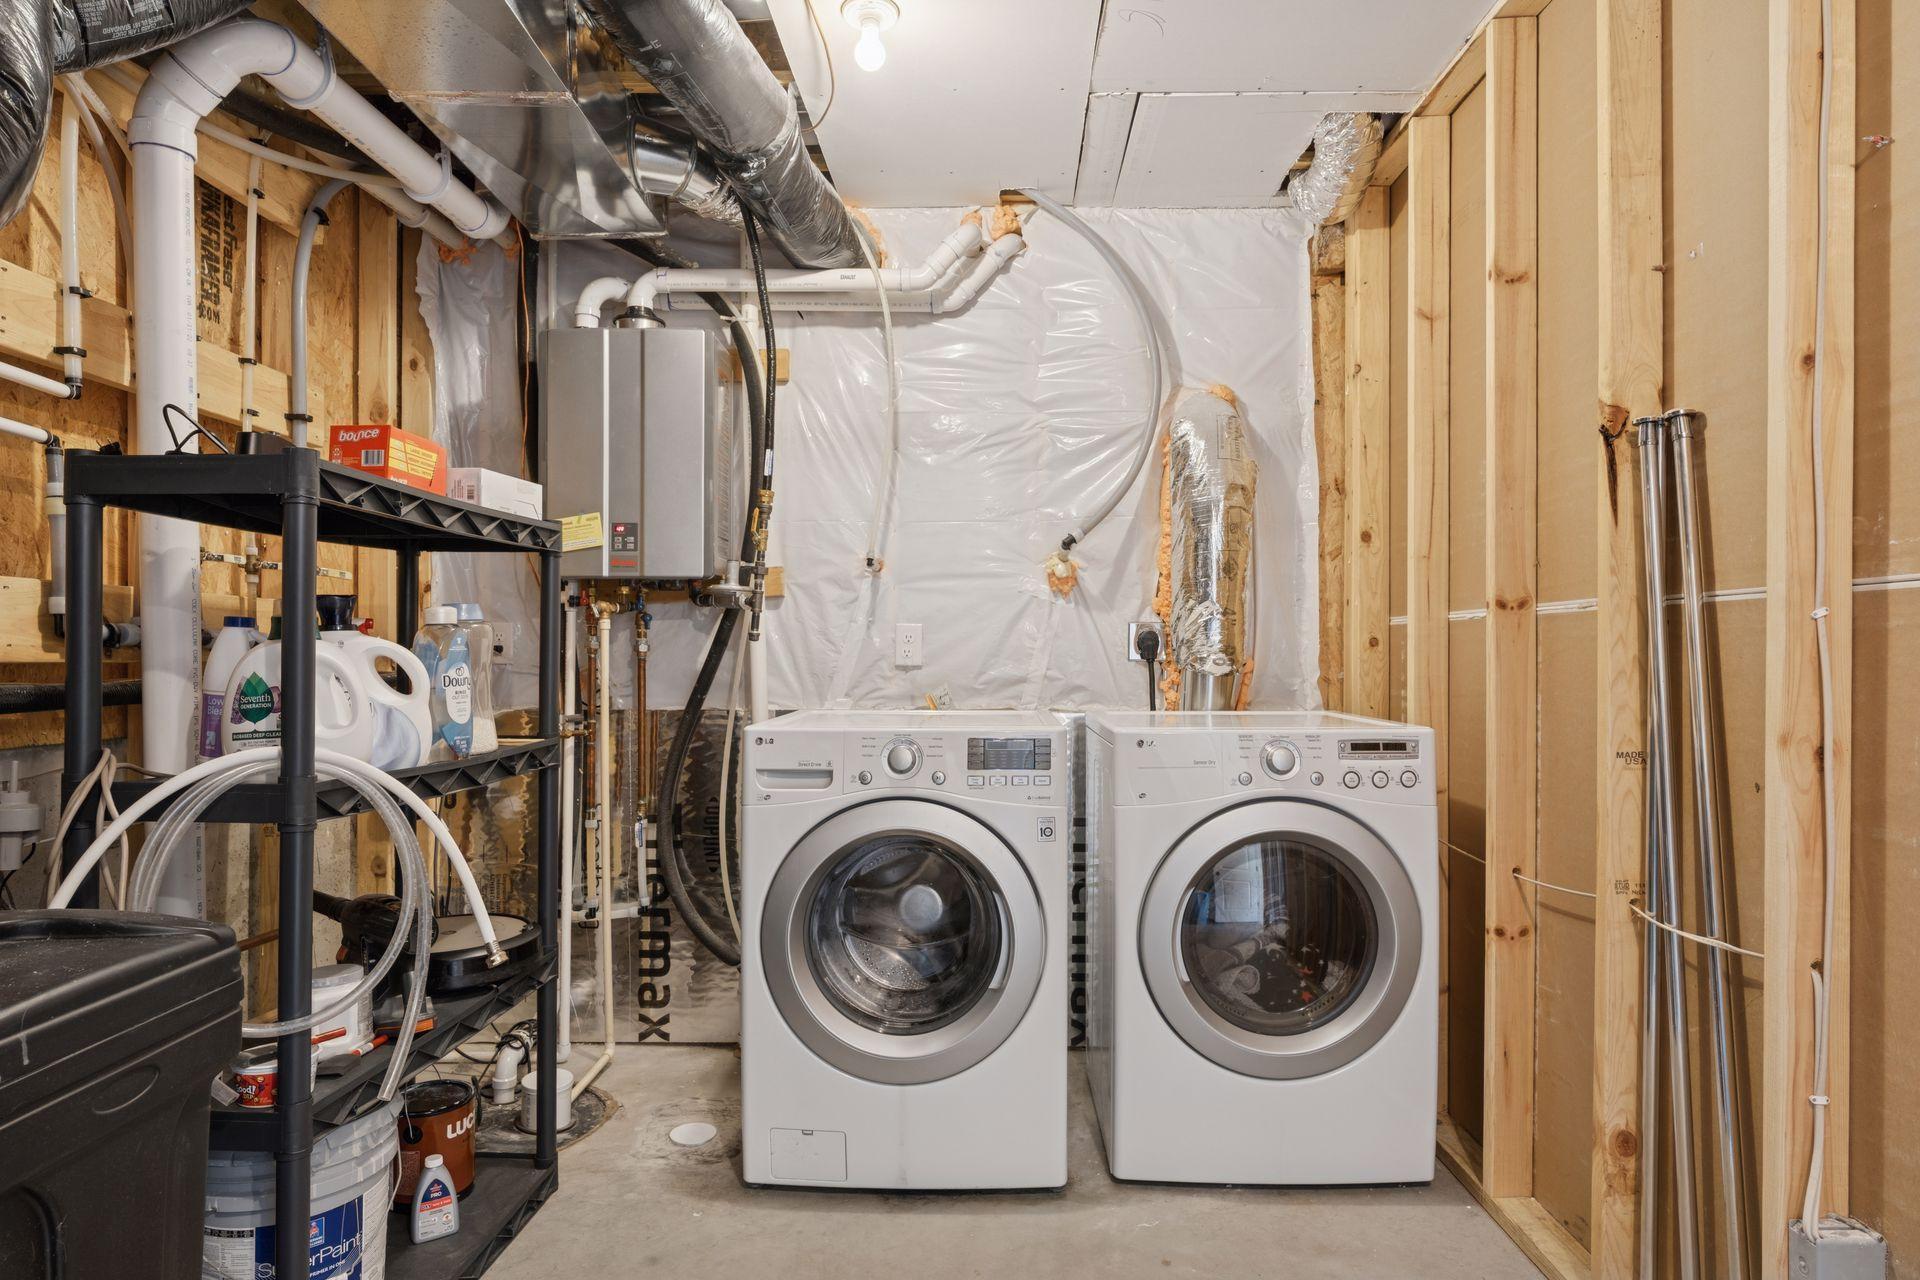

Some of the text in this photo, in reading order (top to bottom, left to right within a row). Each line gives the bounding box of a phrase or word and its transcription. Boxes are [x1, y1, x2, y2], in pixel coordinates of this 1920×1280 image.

[339, 428, 380, 442] bounce
[240, 693, 271, 704] Seventh
[207, 705, 223, 716] Blea
[1616, 751, 1644, 759] MADE
[1040, 826, 1053, 837] 10
[236, 1085, 257, 1095] ood!
[446, 1110, 475, 1139] LUC
[430, 1191, 442, 1199] PRO
